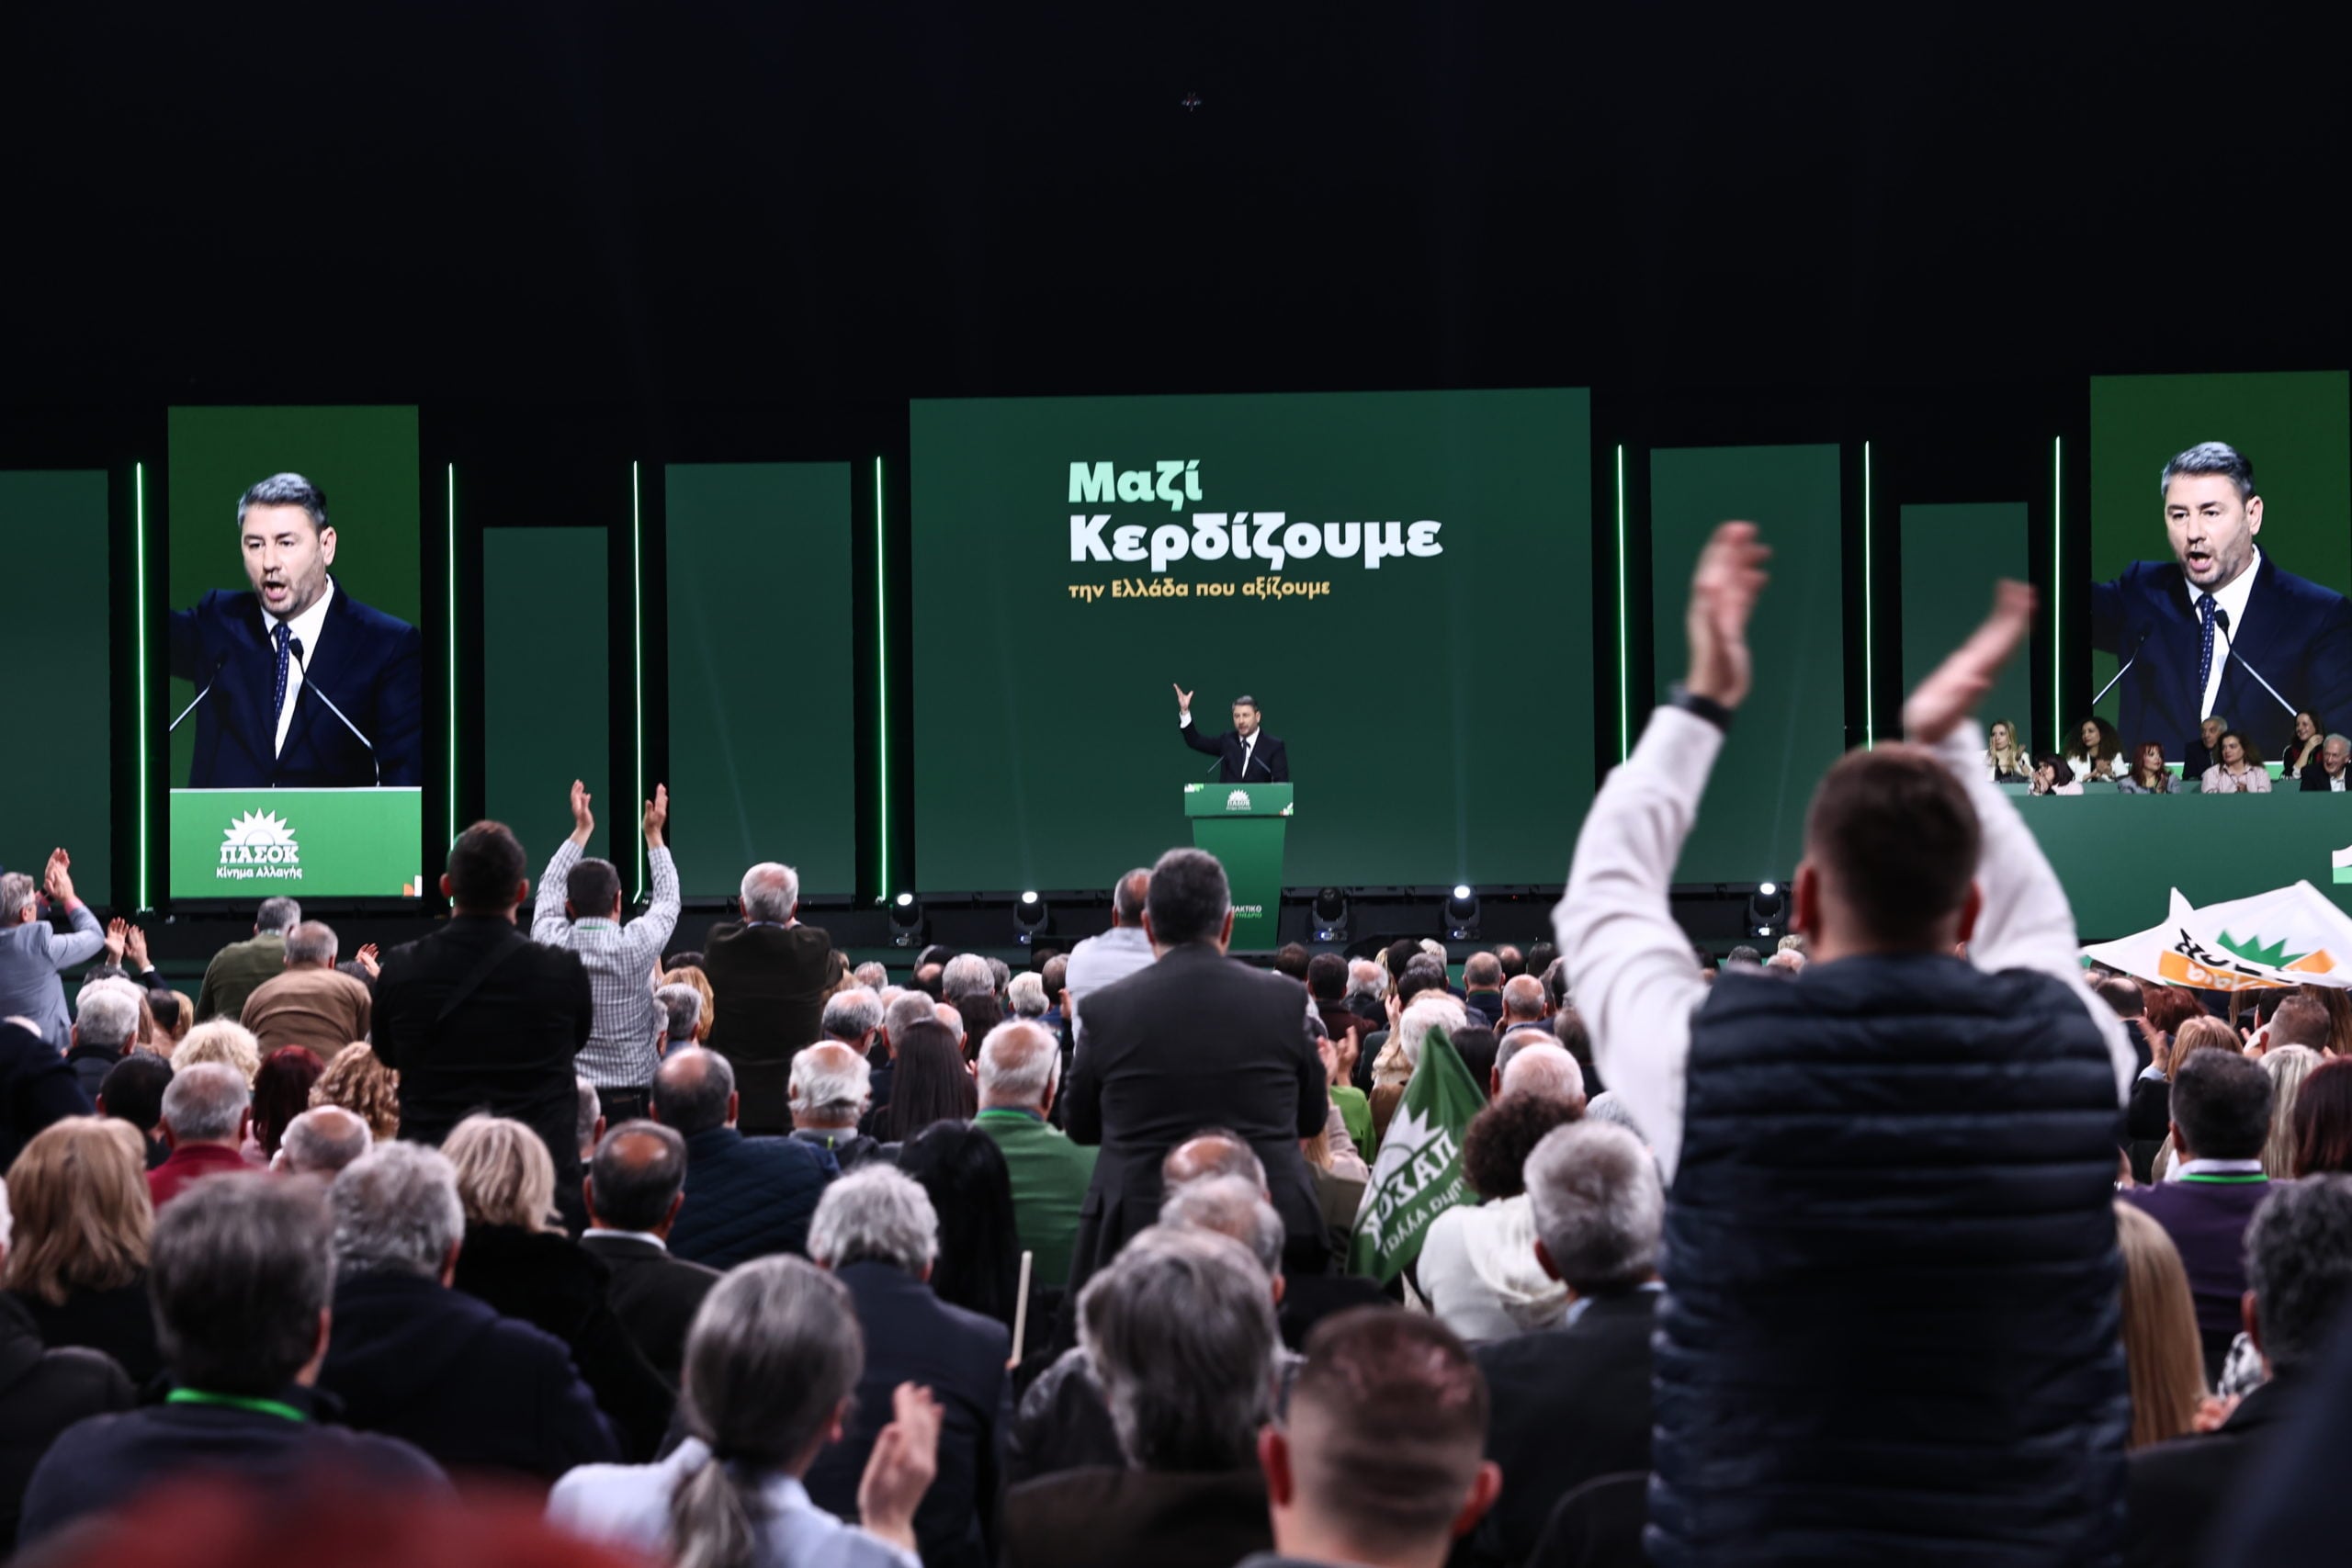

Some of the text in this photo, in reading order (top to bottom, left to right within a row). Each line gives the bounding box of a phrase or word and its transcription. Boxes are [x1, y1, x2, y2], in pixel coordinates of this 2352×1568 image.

[1069, 459, 1203, 512] Μαζί
[1069, 512, 1443, 572] Κερδίζουμε
[1069, 576, 1330, 603] την Ελλάδα που αξίζουμε
[220, 845, 300, 864] ΠΑΣΟΚ
[216, 864, 302, 880] Κίνημα Αλλαγής
